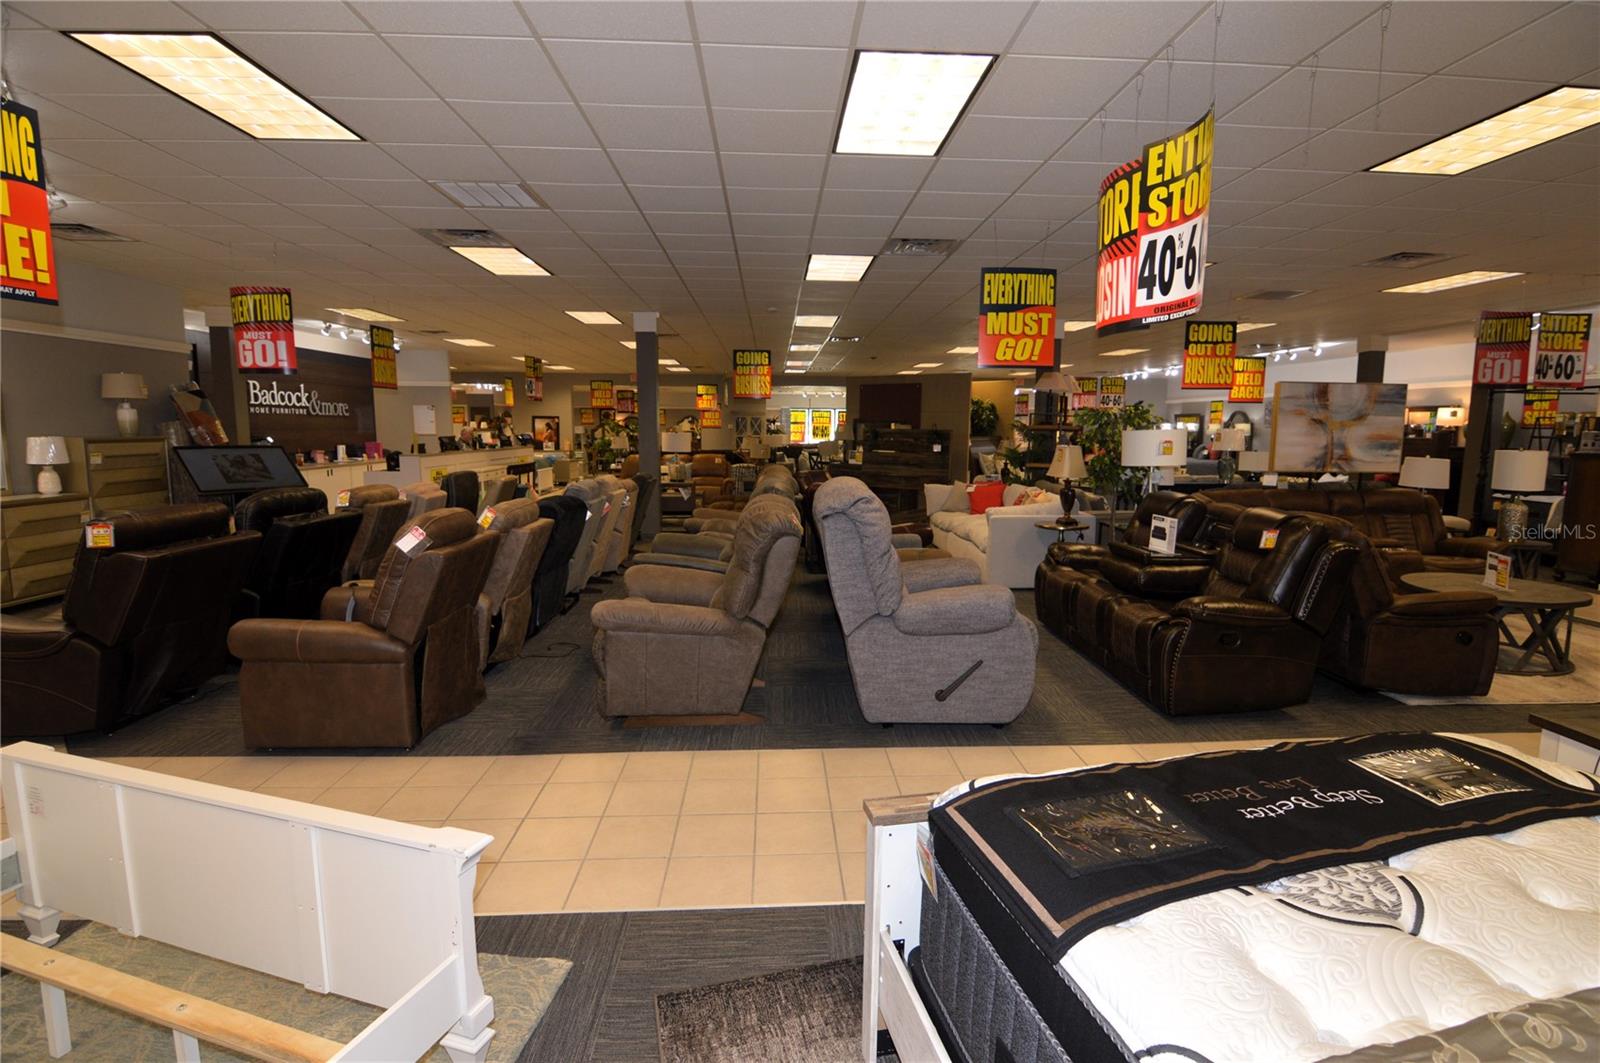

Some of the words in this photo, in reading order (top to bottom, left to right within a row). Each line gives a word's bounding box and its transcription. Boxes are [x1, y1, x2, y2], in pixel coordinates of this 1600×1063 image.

[983, 272, 1055, 306] EVERYTHING
[232, 293, 290, 324] EVERYTHING
[1152, 299, 1189, 314] ORIGINAL
[986, 311, 1052, 336] MUST
[1142, 314, 1169, 324] LIMITED
[1541, 315, 1588, 331] ENTIRE
[1189, 324, 1233, 342] GOING
[1479, 317, 1531, 343] EVERYTHING
[995, 337, 1044, 361] GO!
[1188, 343, 1213, 356] OUT
[1215, 343, 1233, 356] OF
[1540, 332, 1584, 350] STORE
[238, 339, 289, 367] GO!
[736, 351, 769, 365] GOING
[736, 366, 755, 375] OUT
[757, 366, 769, 375] OF
[1184, 357, 1233, 385] BUSINESS
[1235, 373, 1262, 385] HELD
[1477, 358, 1522, 384] GO!
[247, 380, 310, 406] Badcock
[736, 375, 770, 394] BUSINESS
[1231, 386, 1264, 399] BACK!
[271, 407, 307, 415] FURNITURE
[1184, 785, 1268, 802] Better
[1310, 788, 1384, 805] Sleep
[1237, 795, 1324, 819] Better
